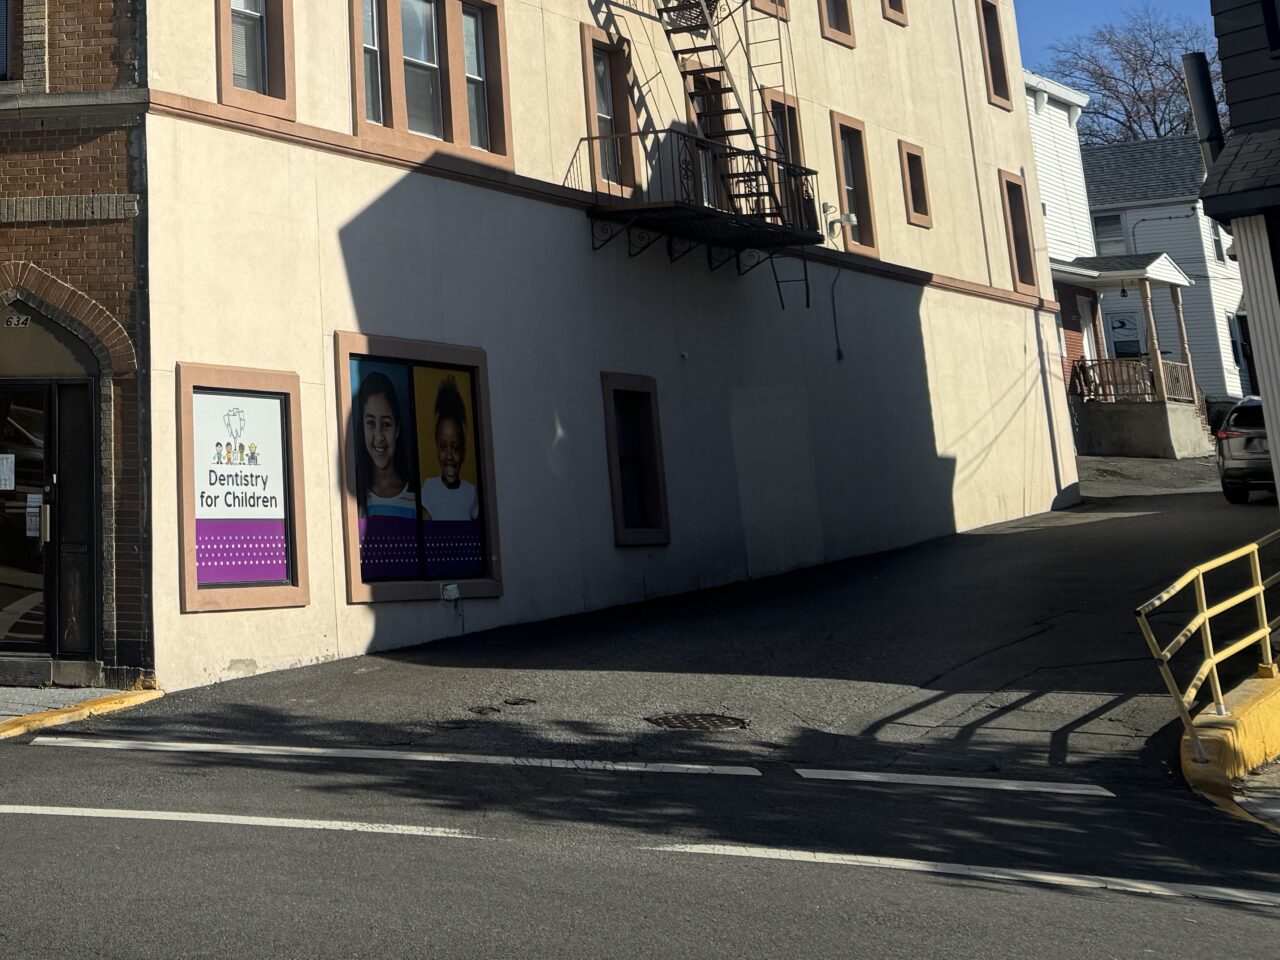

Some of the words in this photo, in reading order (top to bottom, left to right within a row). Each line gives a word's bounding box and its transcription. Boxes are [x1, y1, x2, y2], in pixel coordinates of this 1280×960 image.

[5, 316, 29, 327] 634
[208, 469, 269, 491] Dentistry
[199, 490, 220, 508] for
[224, 490, 278, 508] Children
